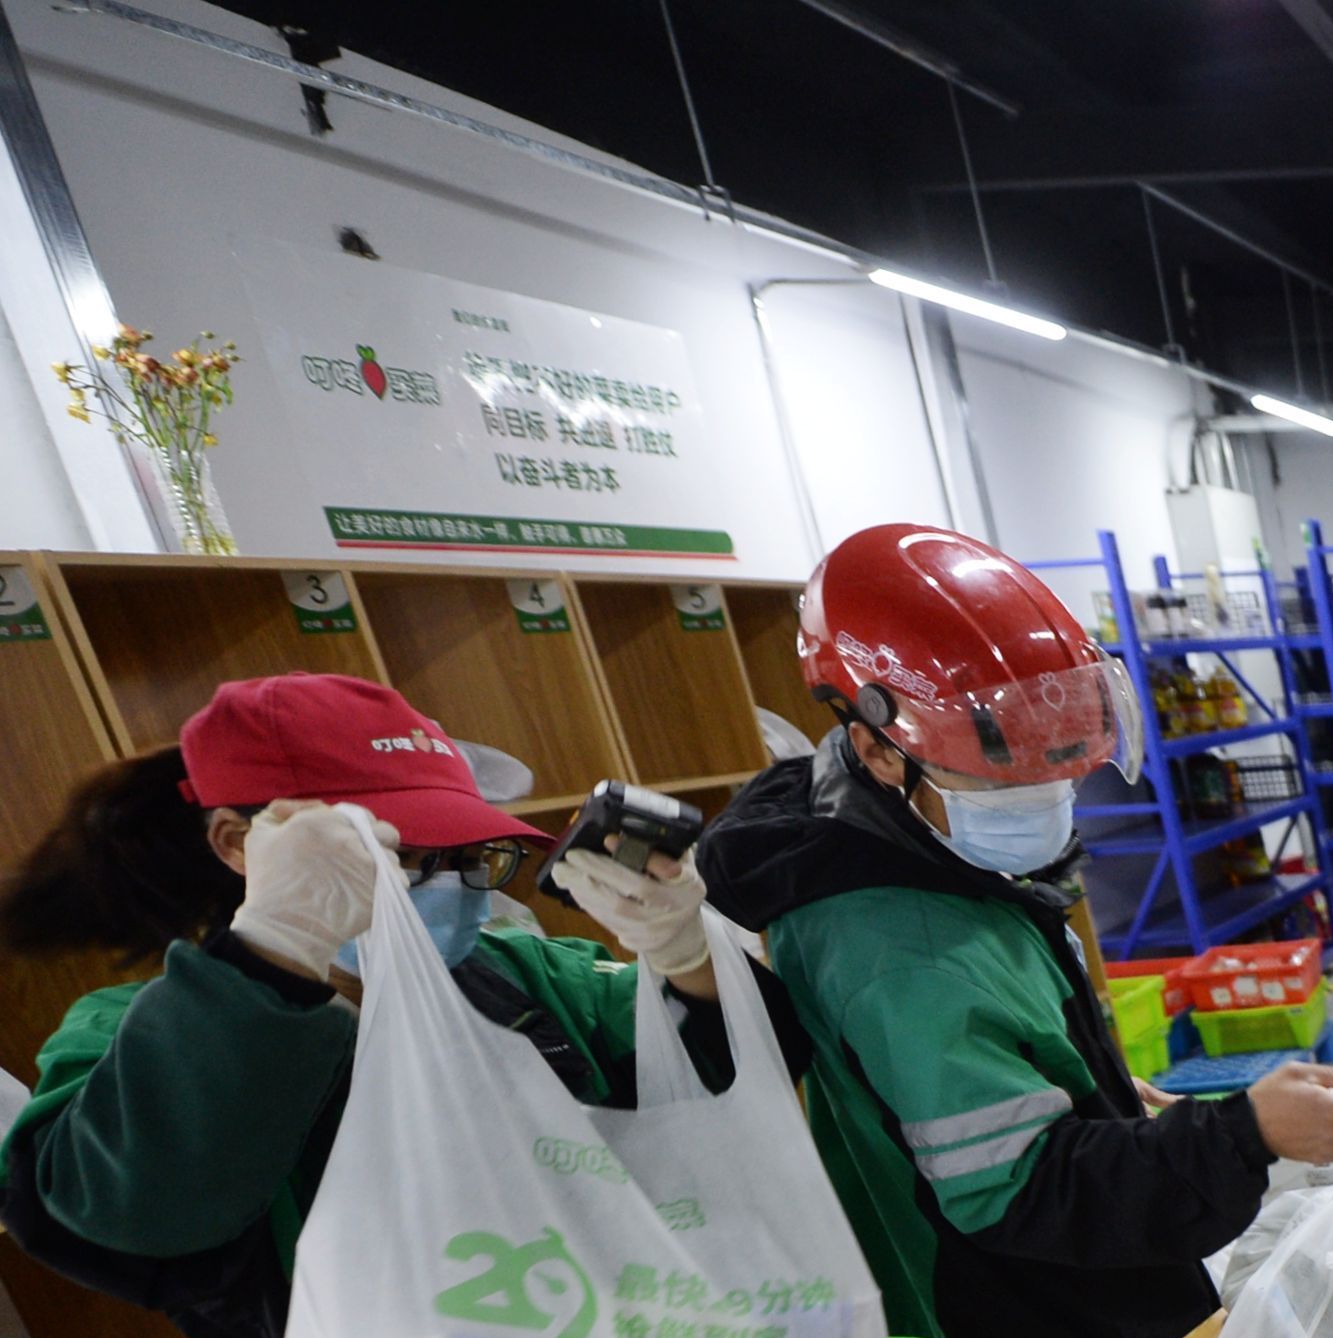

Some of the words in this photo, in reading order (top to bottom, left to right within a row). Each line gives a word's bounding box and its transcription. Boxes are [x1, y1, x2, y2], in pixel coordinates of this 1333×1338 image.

[495, 452, 621, 492] 以奋斗者为本
[306, 575, 329, 604] 3
[527, 584, 545, 608] 4
[687, 586, 706, 609] 5
